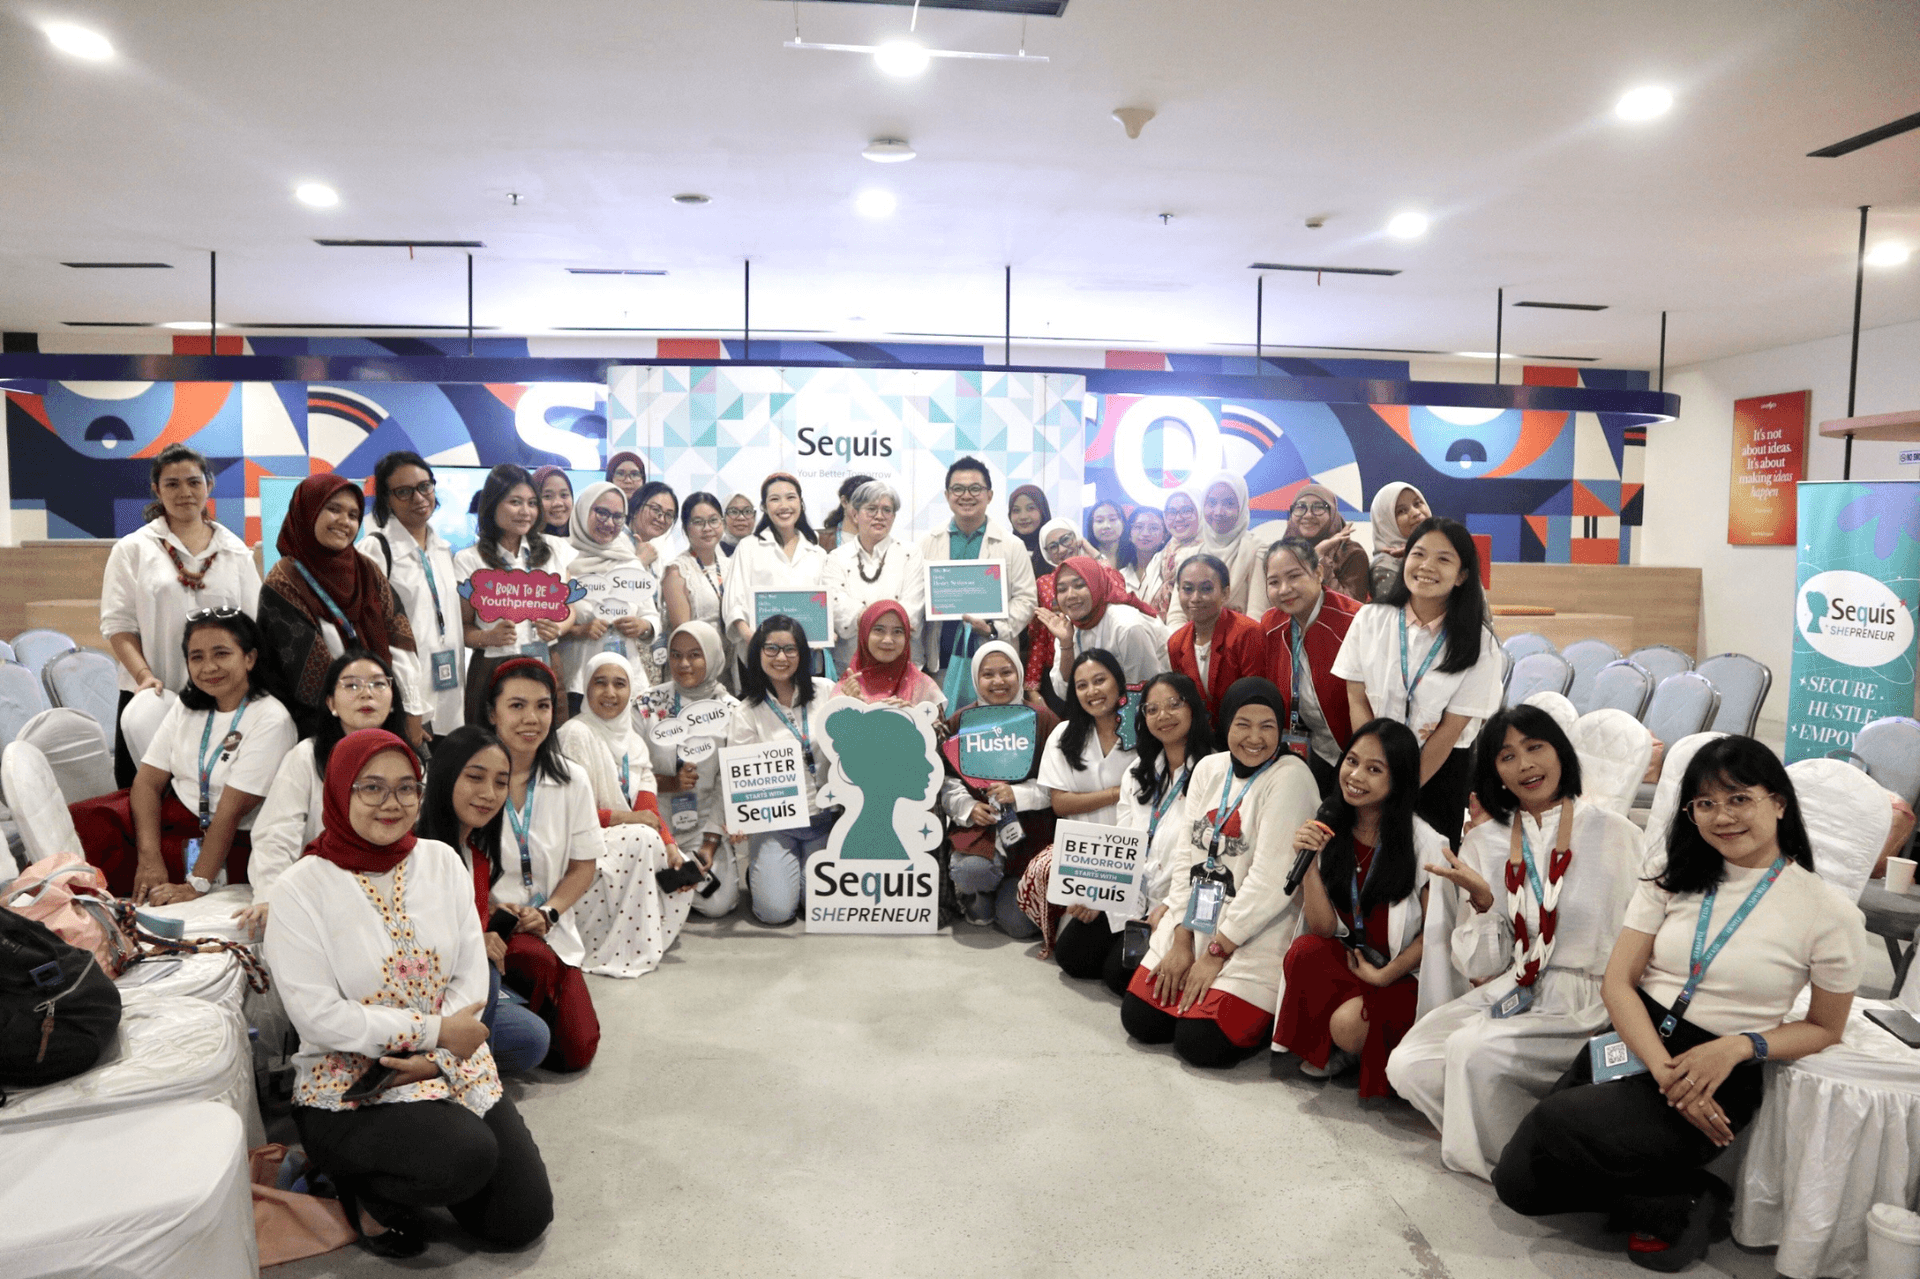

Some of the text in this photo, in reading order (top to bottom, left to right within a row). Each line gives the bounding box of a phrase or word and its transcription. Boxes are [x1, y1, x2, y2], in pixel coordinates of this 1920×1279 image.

[1753, 429, 1782, 441] It's not
[797, 427, 892, 464] Sequis
[1742, 444, 1767, 457] about
[1747, 457, 1785, 470] It's about
[798, 469, 892, 479] Your Better Tomorrow
[1739, 470, 1793, 486] making ideas
[1751, 486, 1779, 501] happen
[577, 581, 606, 592] Sequis
[612, 576, 651, 591] Sequis
[535, 585, 548, 598] BE
[480, 596, 560, 610] Youthpreneur
[599, 606, 628, 617] Sequis
[1831, 598, 1896, 627] Sequis
[1830, 626, 1896, 642] SHEPRENEUR
[1807, 675, 1878, 700] SECURE
[686, 708, 725, 726] Sequis
[1808, 700, 1877, 725] HUSTLE
[654, 725, 684, 740] Sequis
[683, 742, 712, 757] Sequis
[966, 733, 1029, 753] Hustle
[762, 748, 794, 760] YOUR
[731, 759, 796, 778] BETTER
[732, 774, 797, 789] TOMORROW
[745, 790, 785, 800] STARTS WITH
[737, 800, 797, 823] Sequis
[1105, 834, 1139, 847] YOUR
[1065, 840, 1137, 861] BETTER
[1065, 854, 1135, 871] TOMORROW
[1074, 870, 1118, 881] STARTS WITH
[814, 861, 933, 906] Sequis
[1061, 877, 1125, 903] Sequis
[811, 907, 932, 923] SHEPRENEUR
